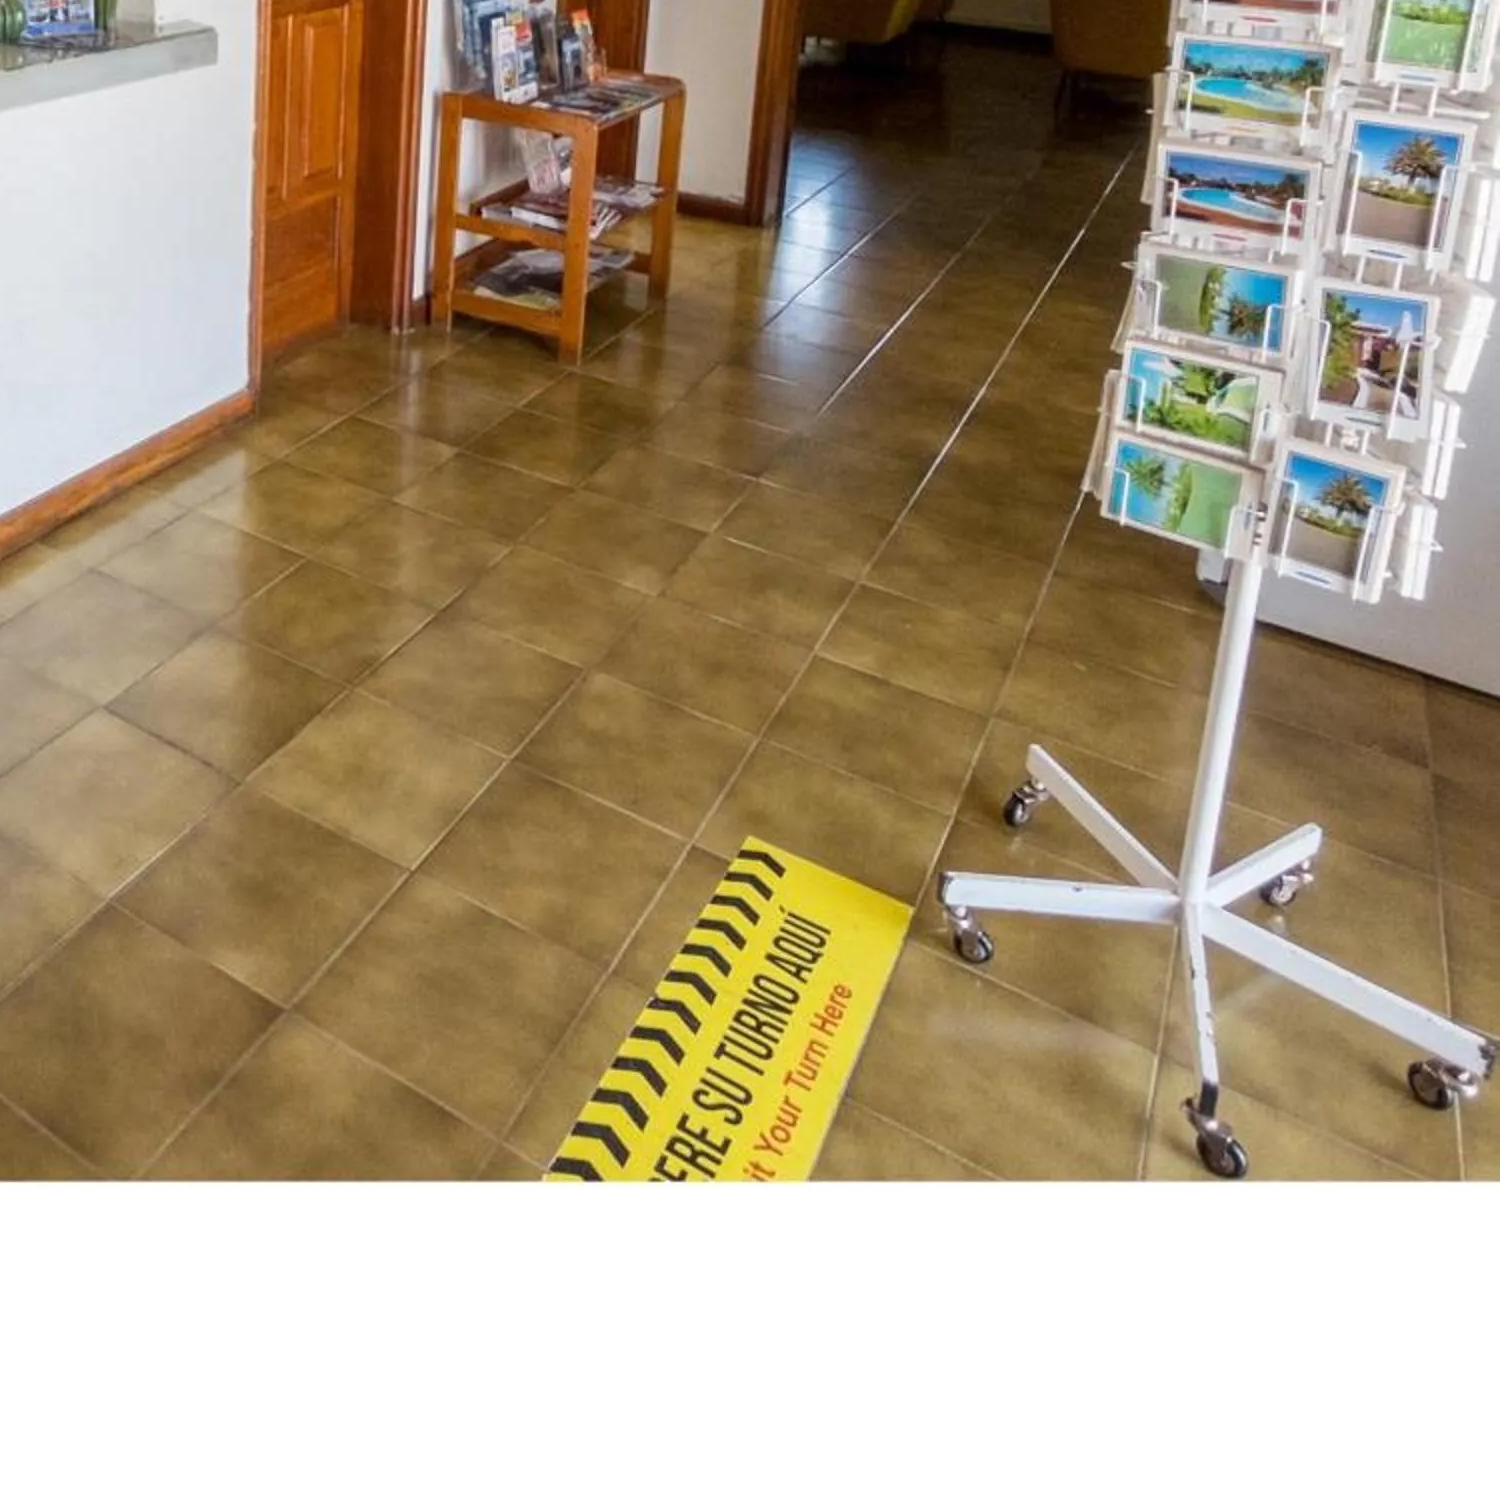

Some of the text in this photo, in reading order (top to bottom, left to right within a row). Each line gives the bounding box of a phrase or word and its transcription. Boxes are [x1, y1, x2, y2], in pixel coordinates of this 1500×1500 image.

[648, 905, 832, 1182] ERE SU TURNO AQUÍ
[753, 1095, 803, 1158] Your
[783, 1036, 830, 1092] Turn
[810, 982, 854, 1036] Here
